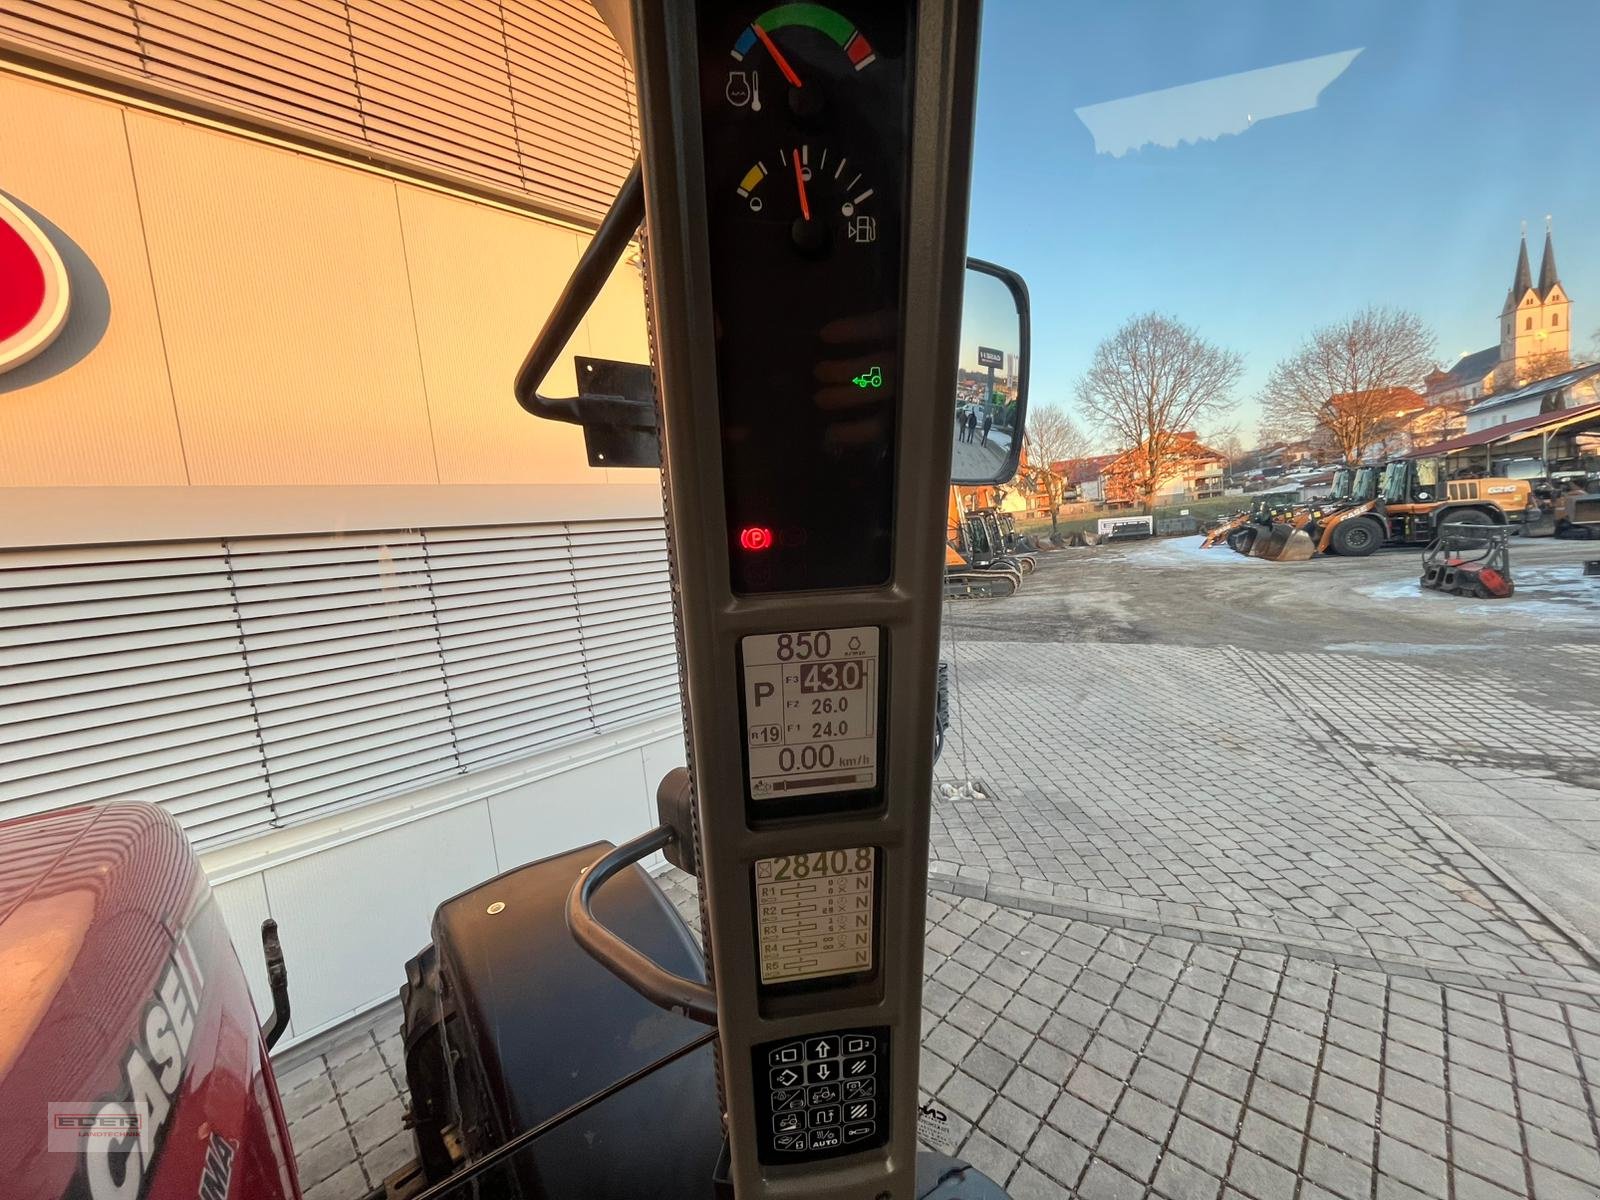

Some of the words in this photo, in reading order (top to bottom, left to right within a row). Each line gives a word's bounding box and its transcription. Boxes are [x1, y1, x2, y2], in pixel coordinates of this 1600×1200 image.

[776, 631, 831, 661] 850
[785, 676, 799, 684] F3
[803, 661, 861, 693] 43.0
[754, 682, 775, 707] P
[786, 700, 800, 709] F2
[811, 696, 849, 715] 26.0
[760, 726, 780, 742] 19
[812, 720, 849, 738] 24.0
[778, 744, 835, 772] 0.00
[773, 847, 872, 880] 2840.8
[762, 887, 776, 896] R1
[856, 876, 869, 890] N
[763, 906, 777, 915] R2
[856, 895, 868, 909] N
[764, 925, 778, 934] R3
[856, 914, 868, 928] N
[764, 944, 778, 953] R4
[856, 932, 868, 945] N
[856, 950, 868, 963] N
[812, 1139, 838, 1148] AUTO
